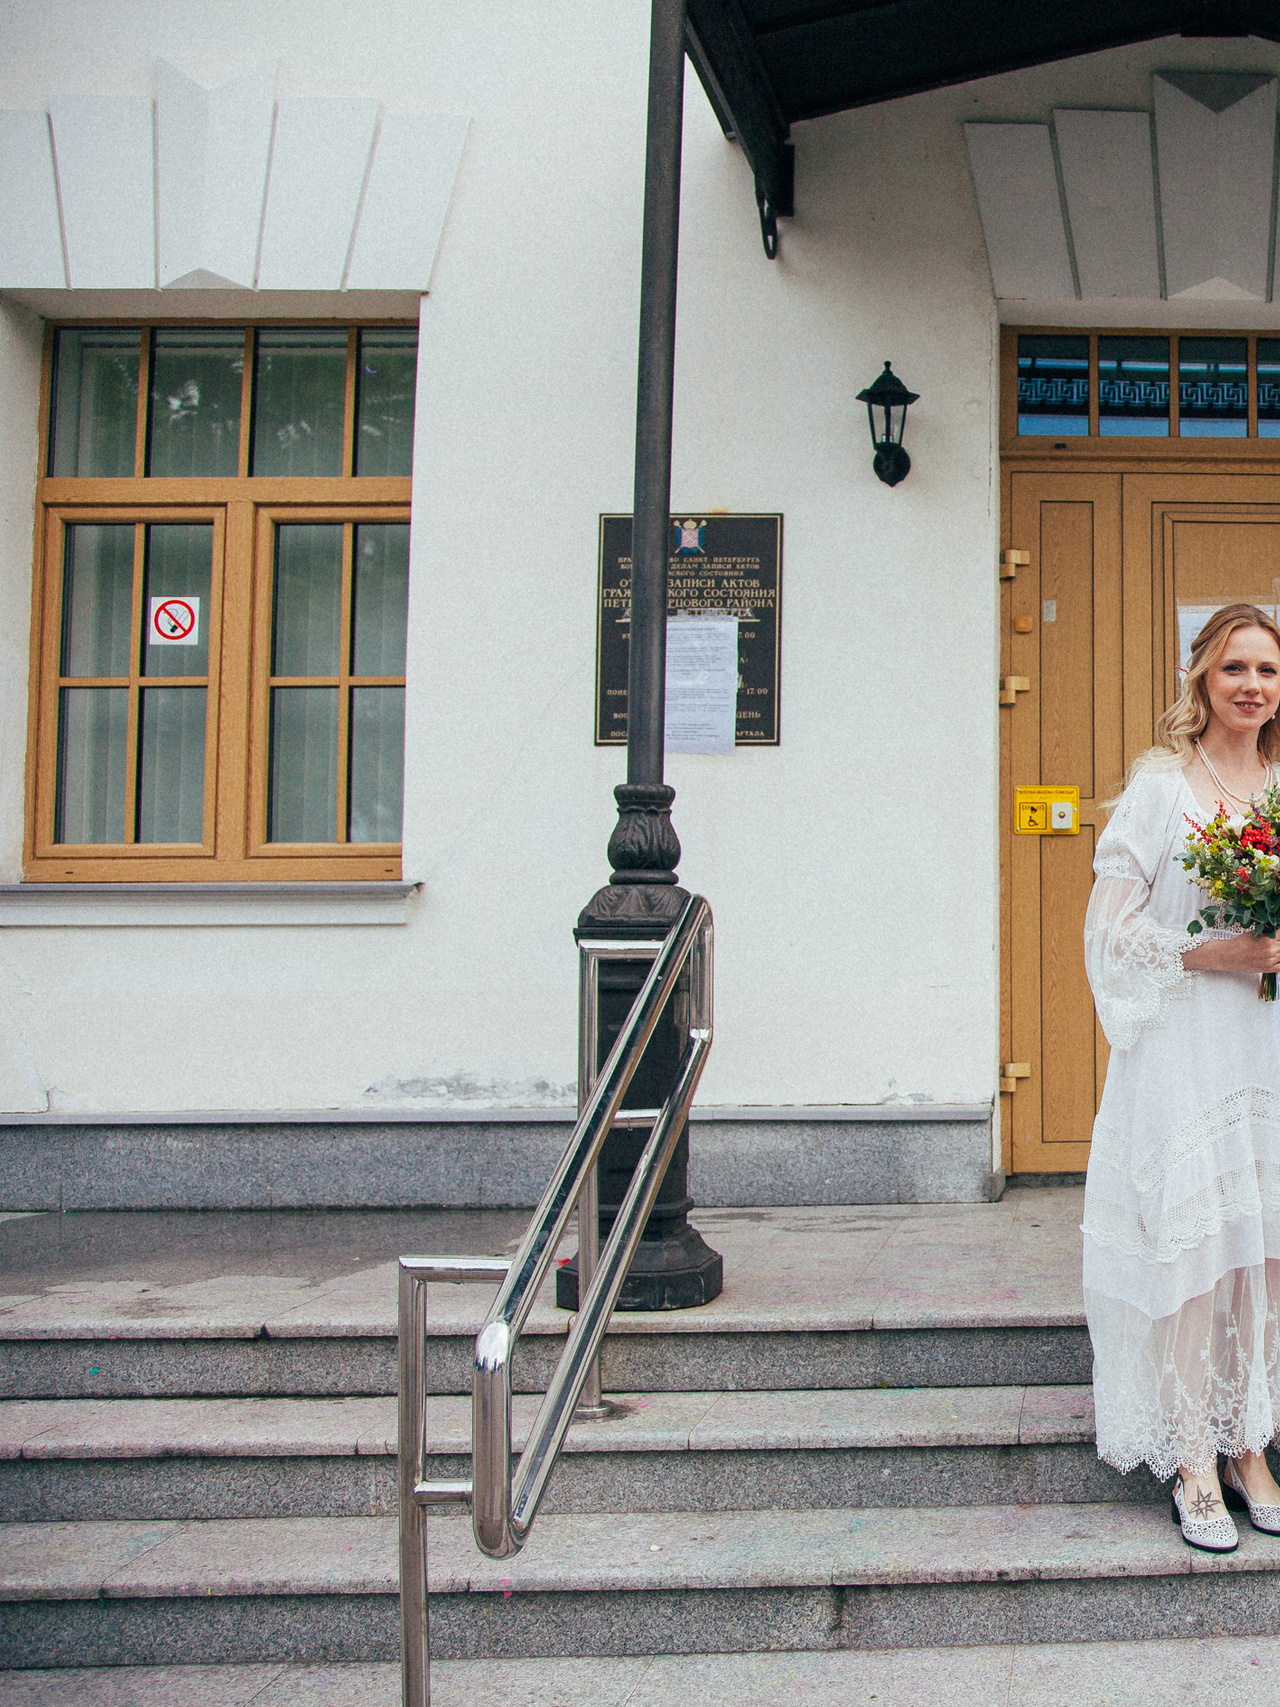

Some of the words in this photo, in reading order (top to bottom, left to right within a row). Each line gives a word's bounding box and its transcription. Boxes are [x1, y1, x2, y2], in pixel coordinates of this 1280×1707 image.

[667, 579, 715, 588] ЗАПИСИ
[721, 579, 760, 588] АКТОВ
[703, 589, 775, 598] СОСТОЯНИЯ
[726, 596, 774, 608] РАЙОНА
[736, 711, 760, 719] ДЕНЬ
